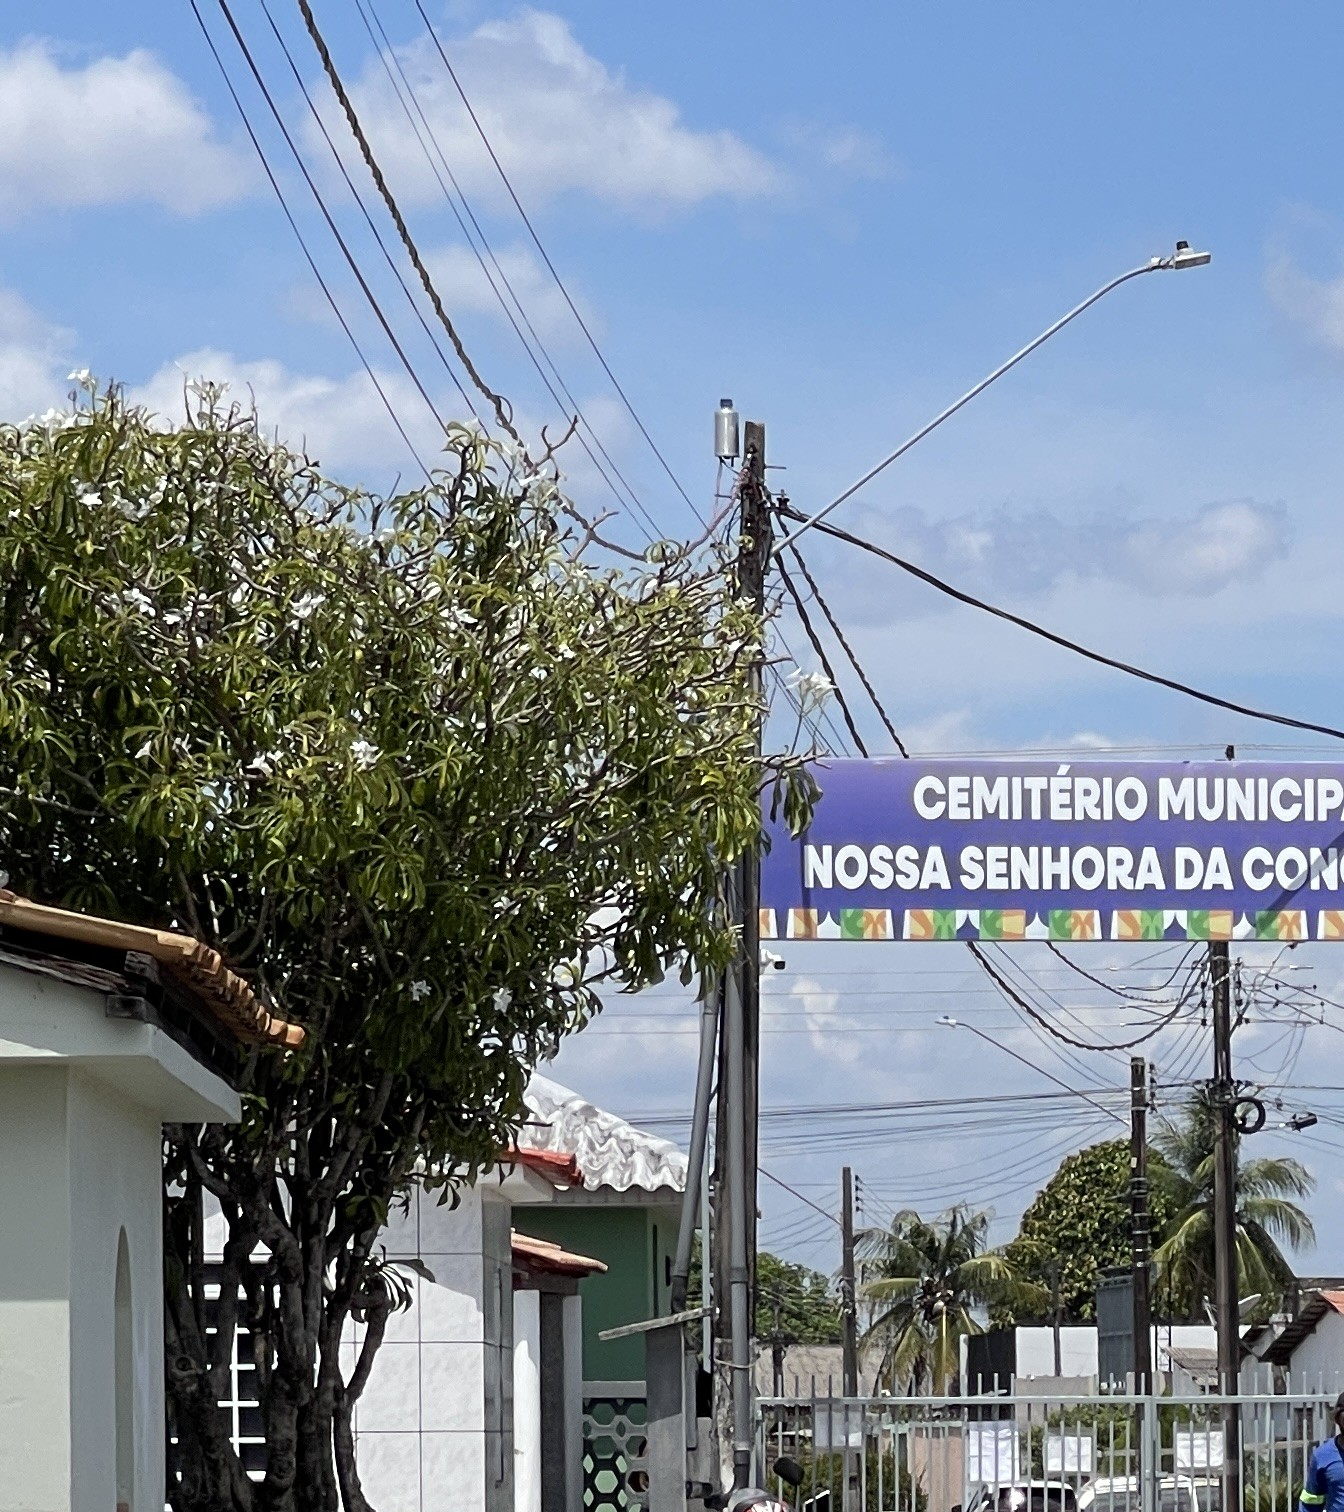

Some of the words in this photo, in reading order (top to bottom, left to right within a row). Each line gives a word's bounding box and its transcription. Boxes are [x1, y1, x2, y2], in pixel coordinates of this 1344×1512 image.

[913, 764, 1148, 821] CEMITÉRIO
[804, 844, 951, 890] NOSSA
[959, 846, 1166, 891] SENHORA
[1174, 846, 1235, 891] DA
